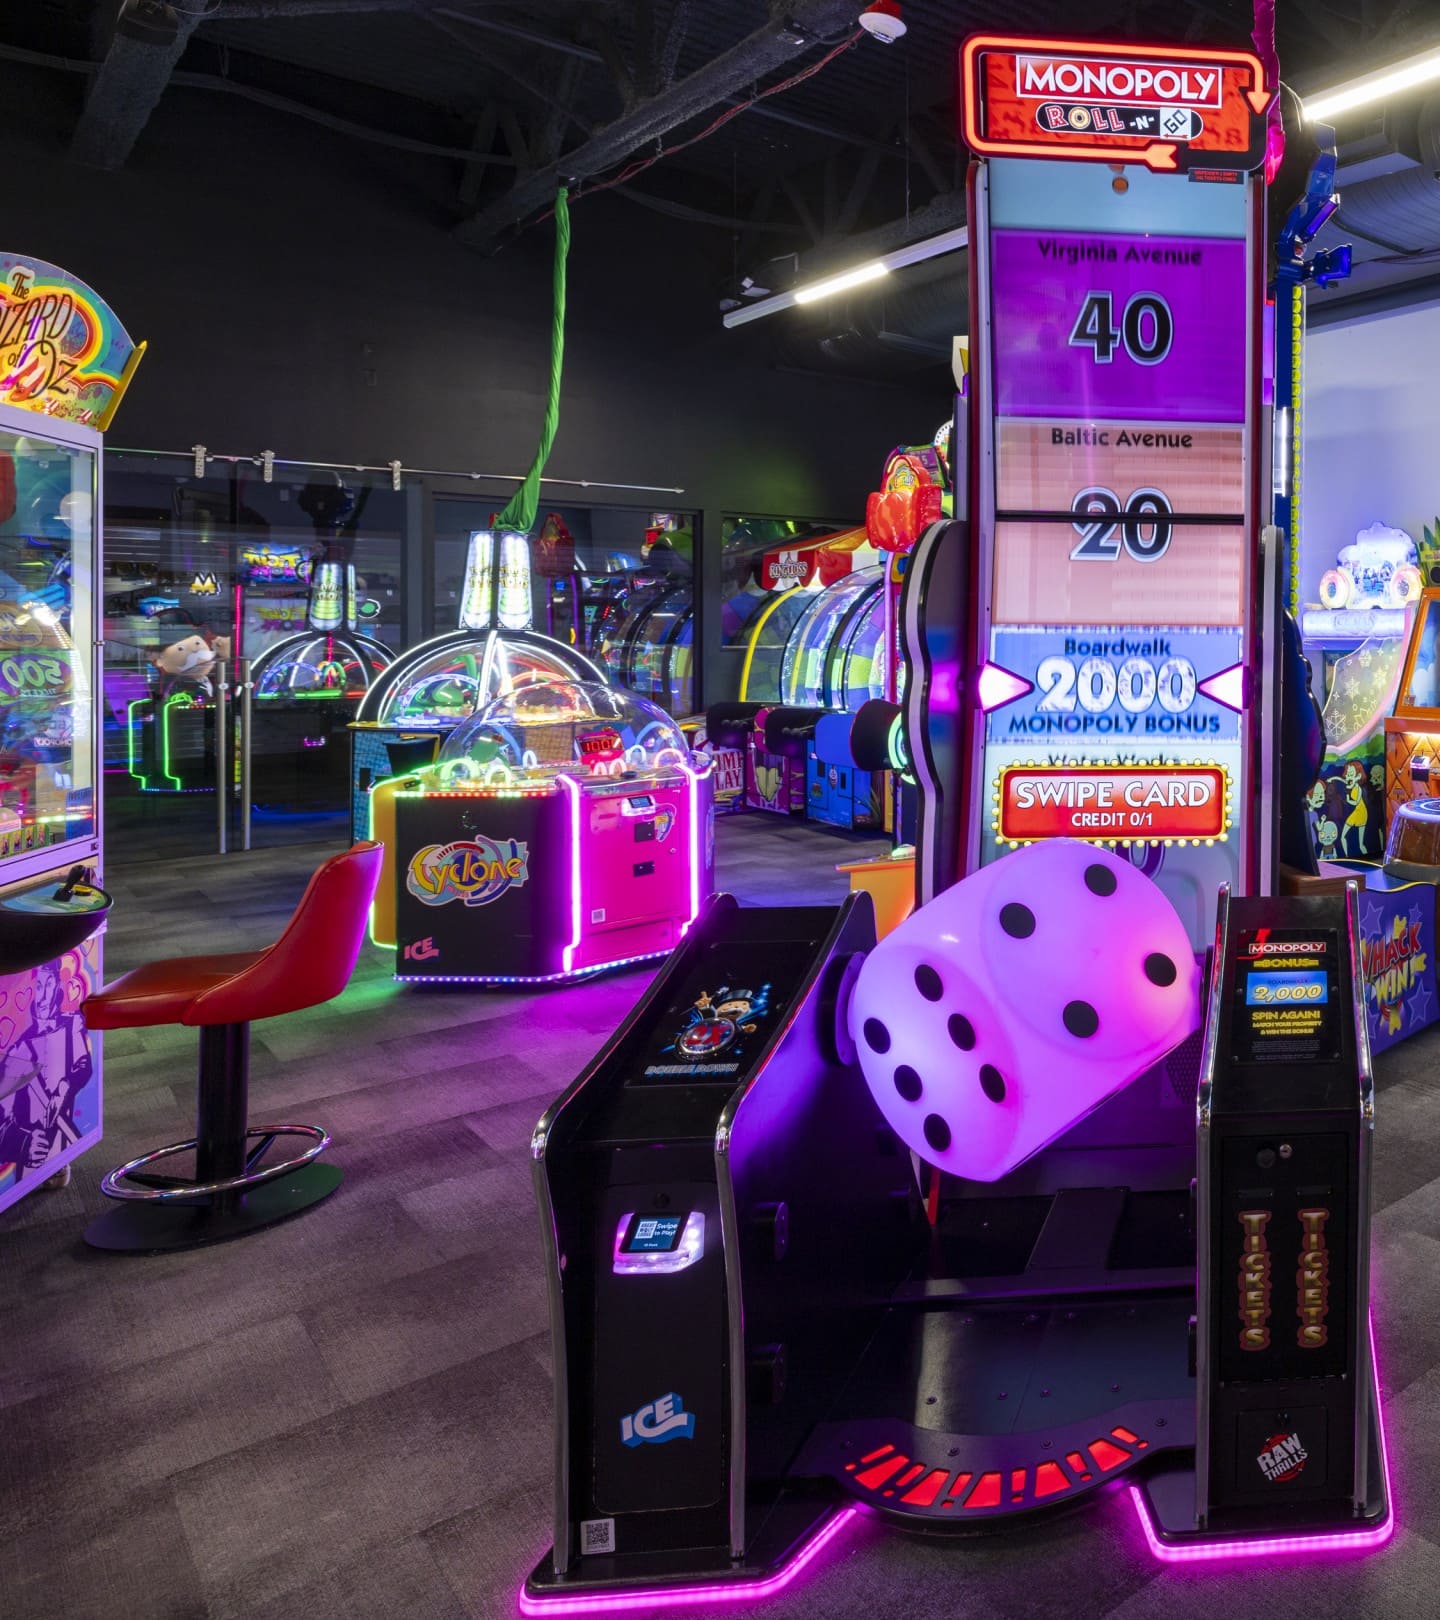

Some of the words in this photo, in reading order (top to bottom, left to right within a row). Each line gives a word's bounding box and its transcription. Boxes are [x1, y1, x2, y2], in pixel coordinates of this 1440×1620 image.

[1023, 61, 1216, 100] MONOPOLY
[1046, 105, 1125, 131] ROLL
[1163, 109, 1189, 134] GO
[1037, 239, 1119, 266] Virginia
[1123, 244, 1205, 267] Avenue
[12, 272, 31, 300] The
[0, 293, 74, 356] IZARD
[1068, 290, 1174, 367] 40
[1051, 427, 1110, 447] Baltic
[1115, 430, 1194, 449] Avenue
[1068, 486, 1174, 563] 20
[1063, 637, 1173, 658] Boardwalk
[1035, 655, 1198, 714] 2000
[1007, 713, 1138, 734] MONOPOLY
[1144, 713, 1221, 734] BONUS
[714, 771, 741, 791] LAY
[1015, 781, 1114, 809] SWIPE
[1123, 780, 1211, 808] CARD
[1071, 811, 1126, 827] CREDIT
[1129, 811, 1153, 827] 0/1
[411, 846, 525, 895] Cyclone
[404, 936, 440, 961] ICE
[1251, 943, 1324, 954] MONOPOLY
[1262, 958, 1309, 968] BONUS
[1253, 984, 1323, 1003] 2,000
[1251, 1011, 1279, 1021] SPIN
[1280, 1010, 1321, 1020] AGAIN!
[644, 1065, 697, 1075] DOUBLE
[696, 1062, 740, 1073] DOWN
[656, 1222, 679, 1230] Swipe
[1243, 1211, 1267, 1348] TICKETS
[1301, 1210, 1326, 1347] TICKETS
[621, 1392, 690, 1443] ICE
[1256, 1432, 1302, 1473] RAW
[1263, 1448, 1308, 1481] THRILLS
